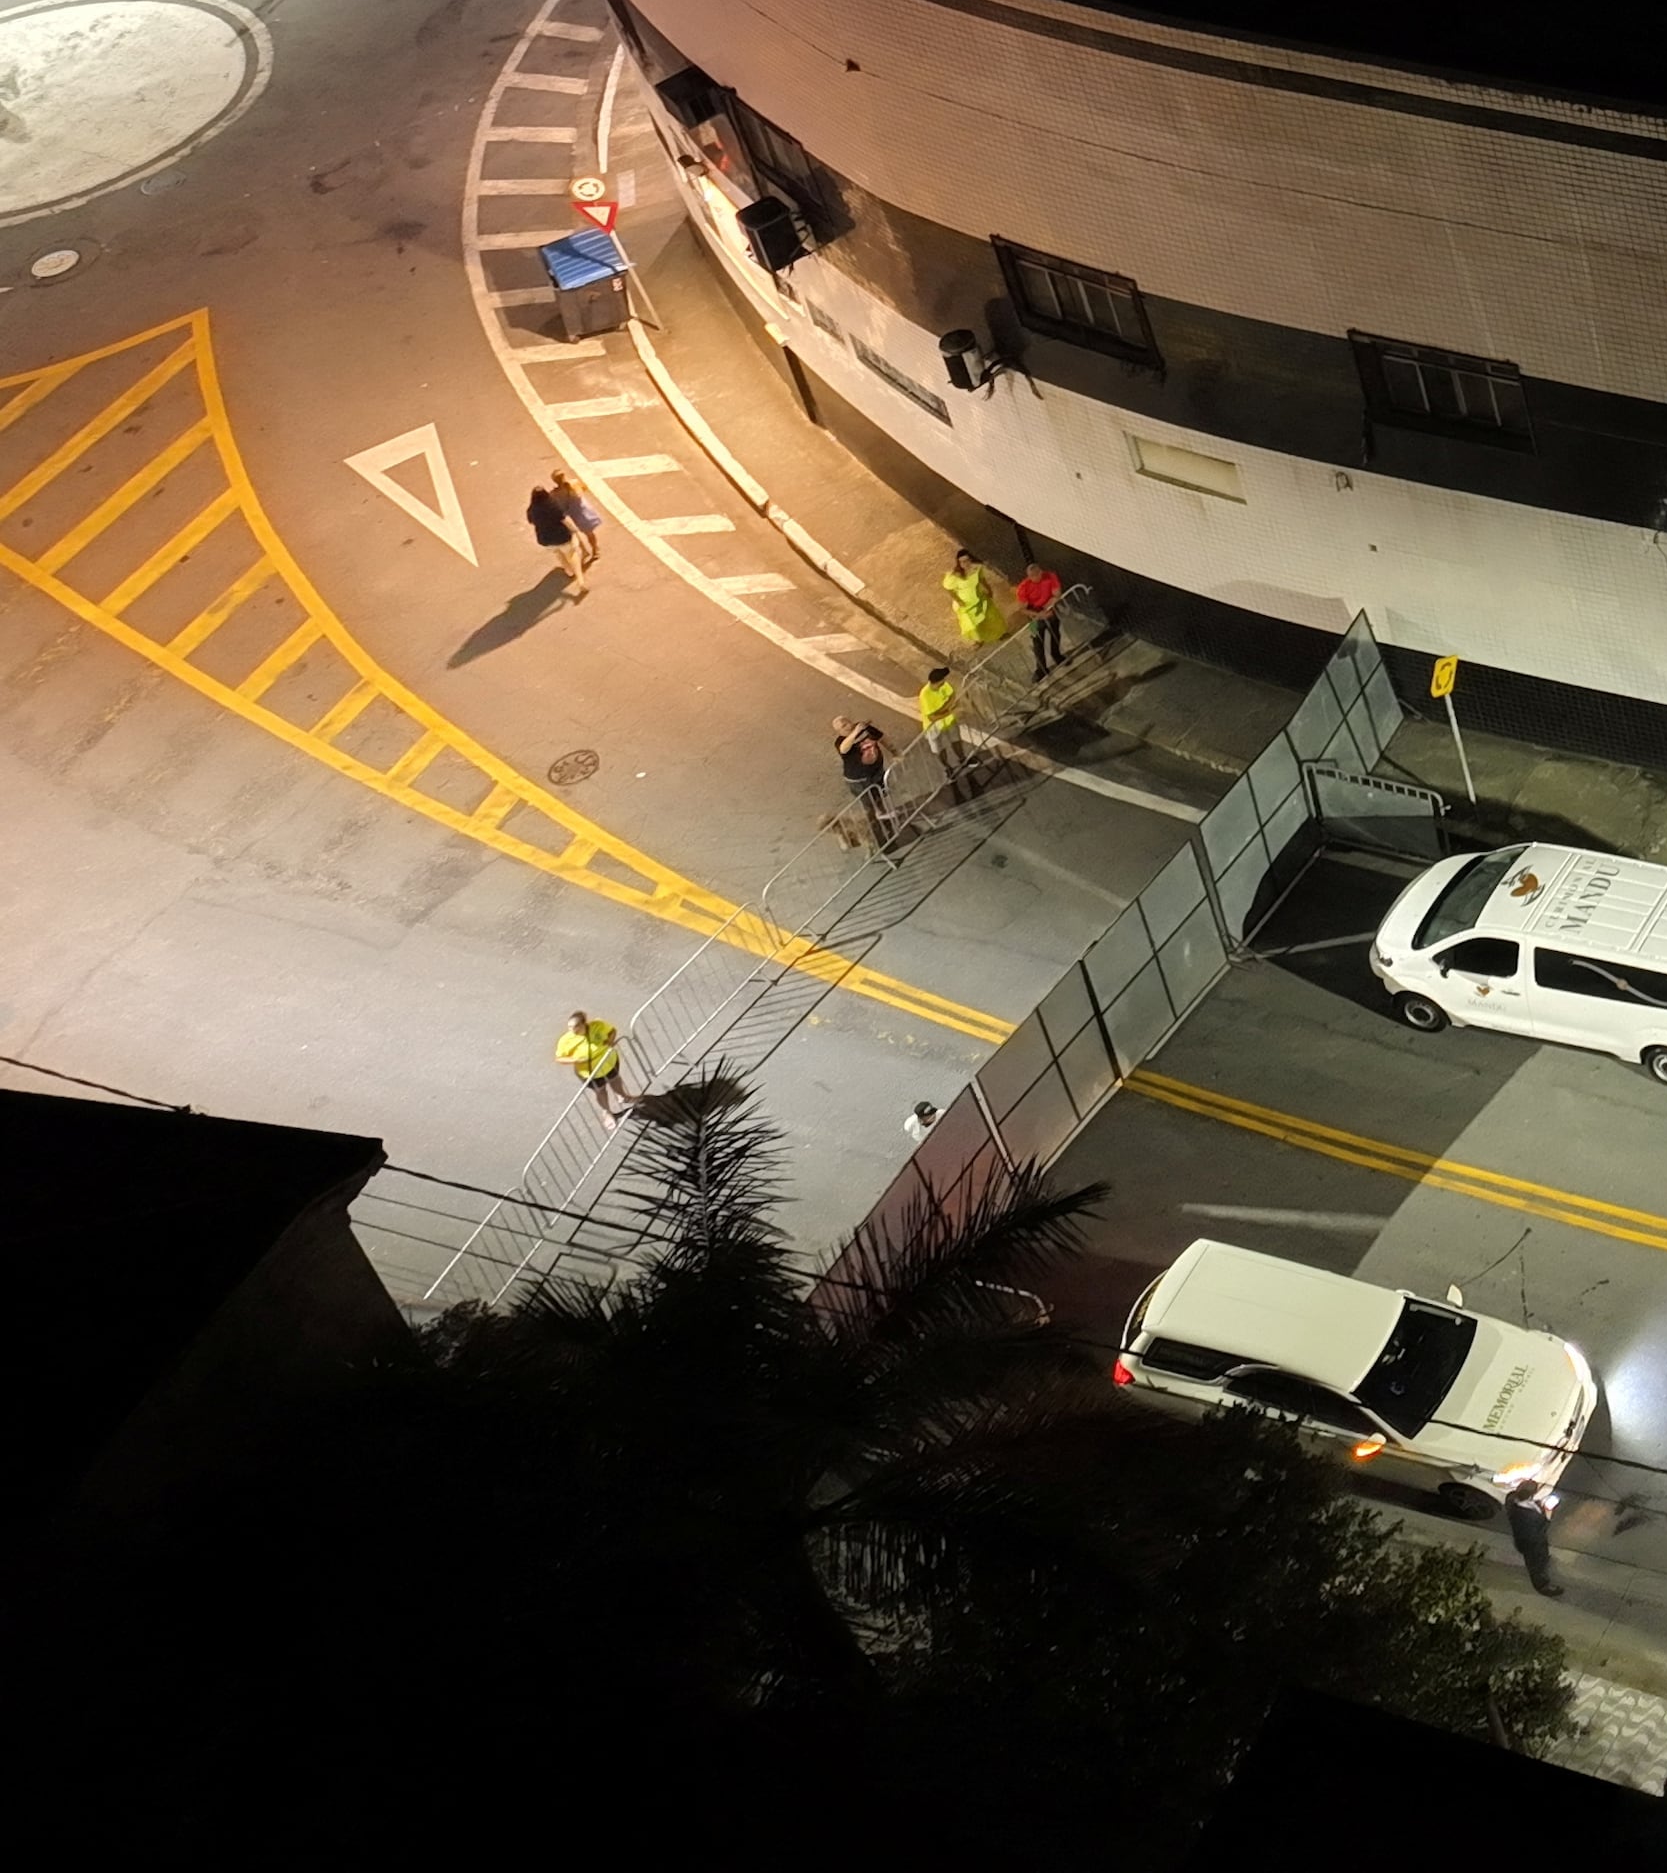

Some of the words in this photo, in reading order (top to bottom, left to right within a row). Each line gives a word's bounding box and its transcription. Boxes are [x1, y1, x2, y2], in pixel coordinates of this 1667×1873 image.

[1545, 858, 1597, 928] CERIMONAL
[1559, 862, 1620, 935] MANDU
[1482, 1364, 1529, 1432] MEMORIAL
